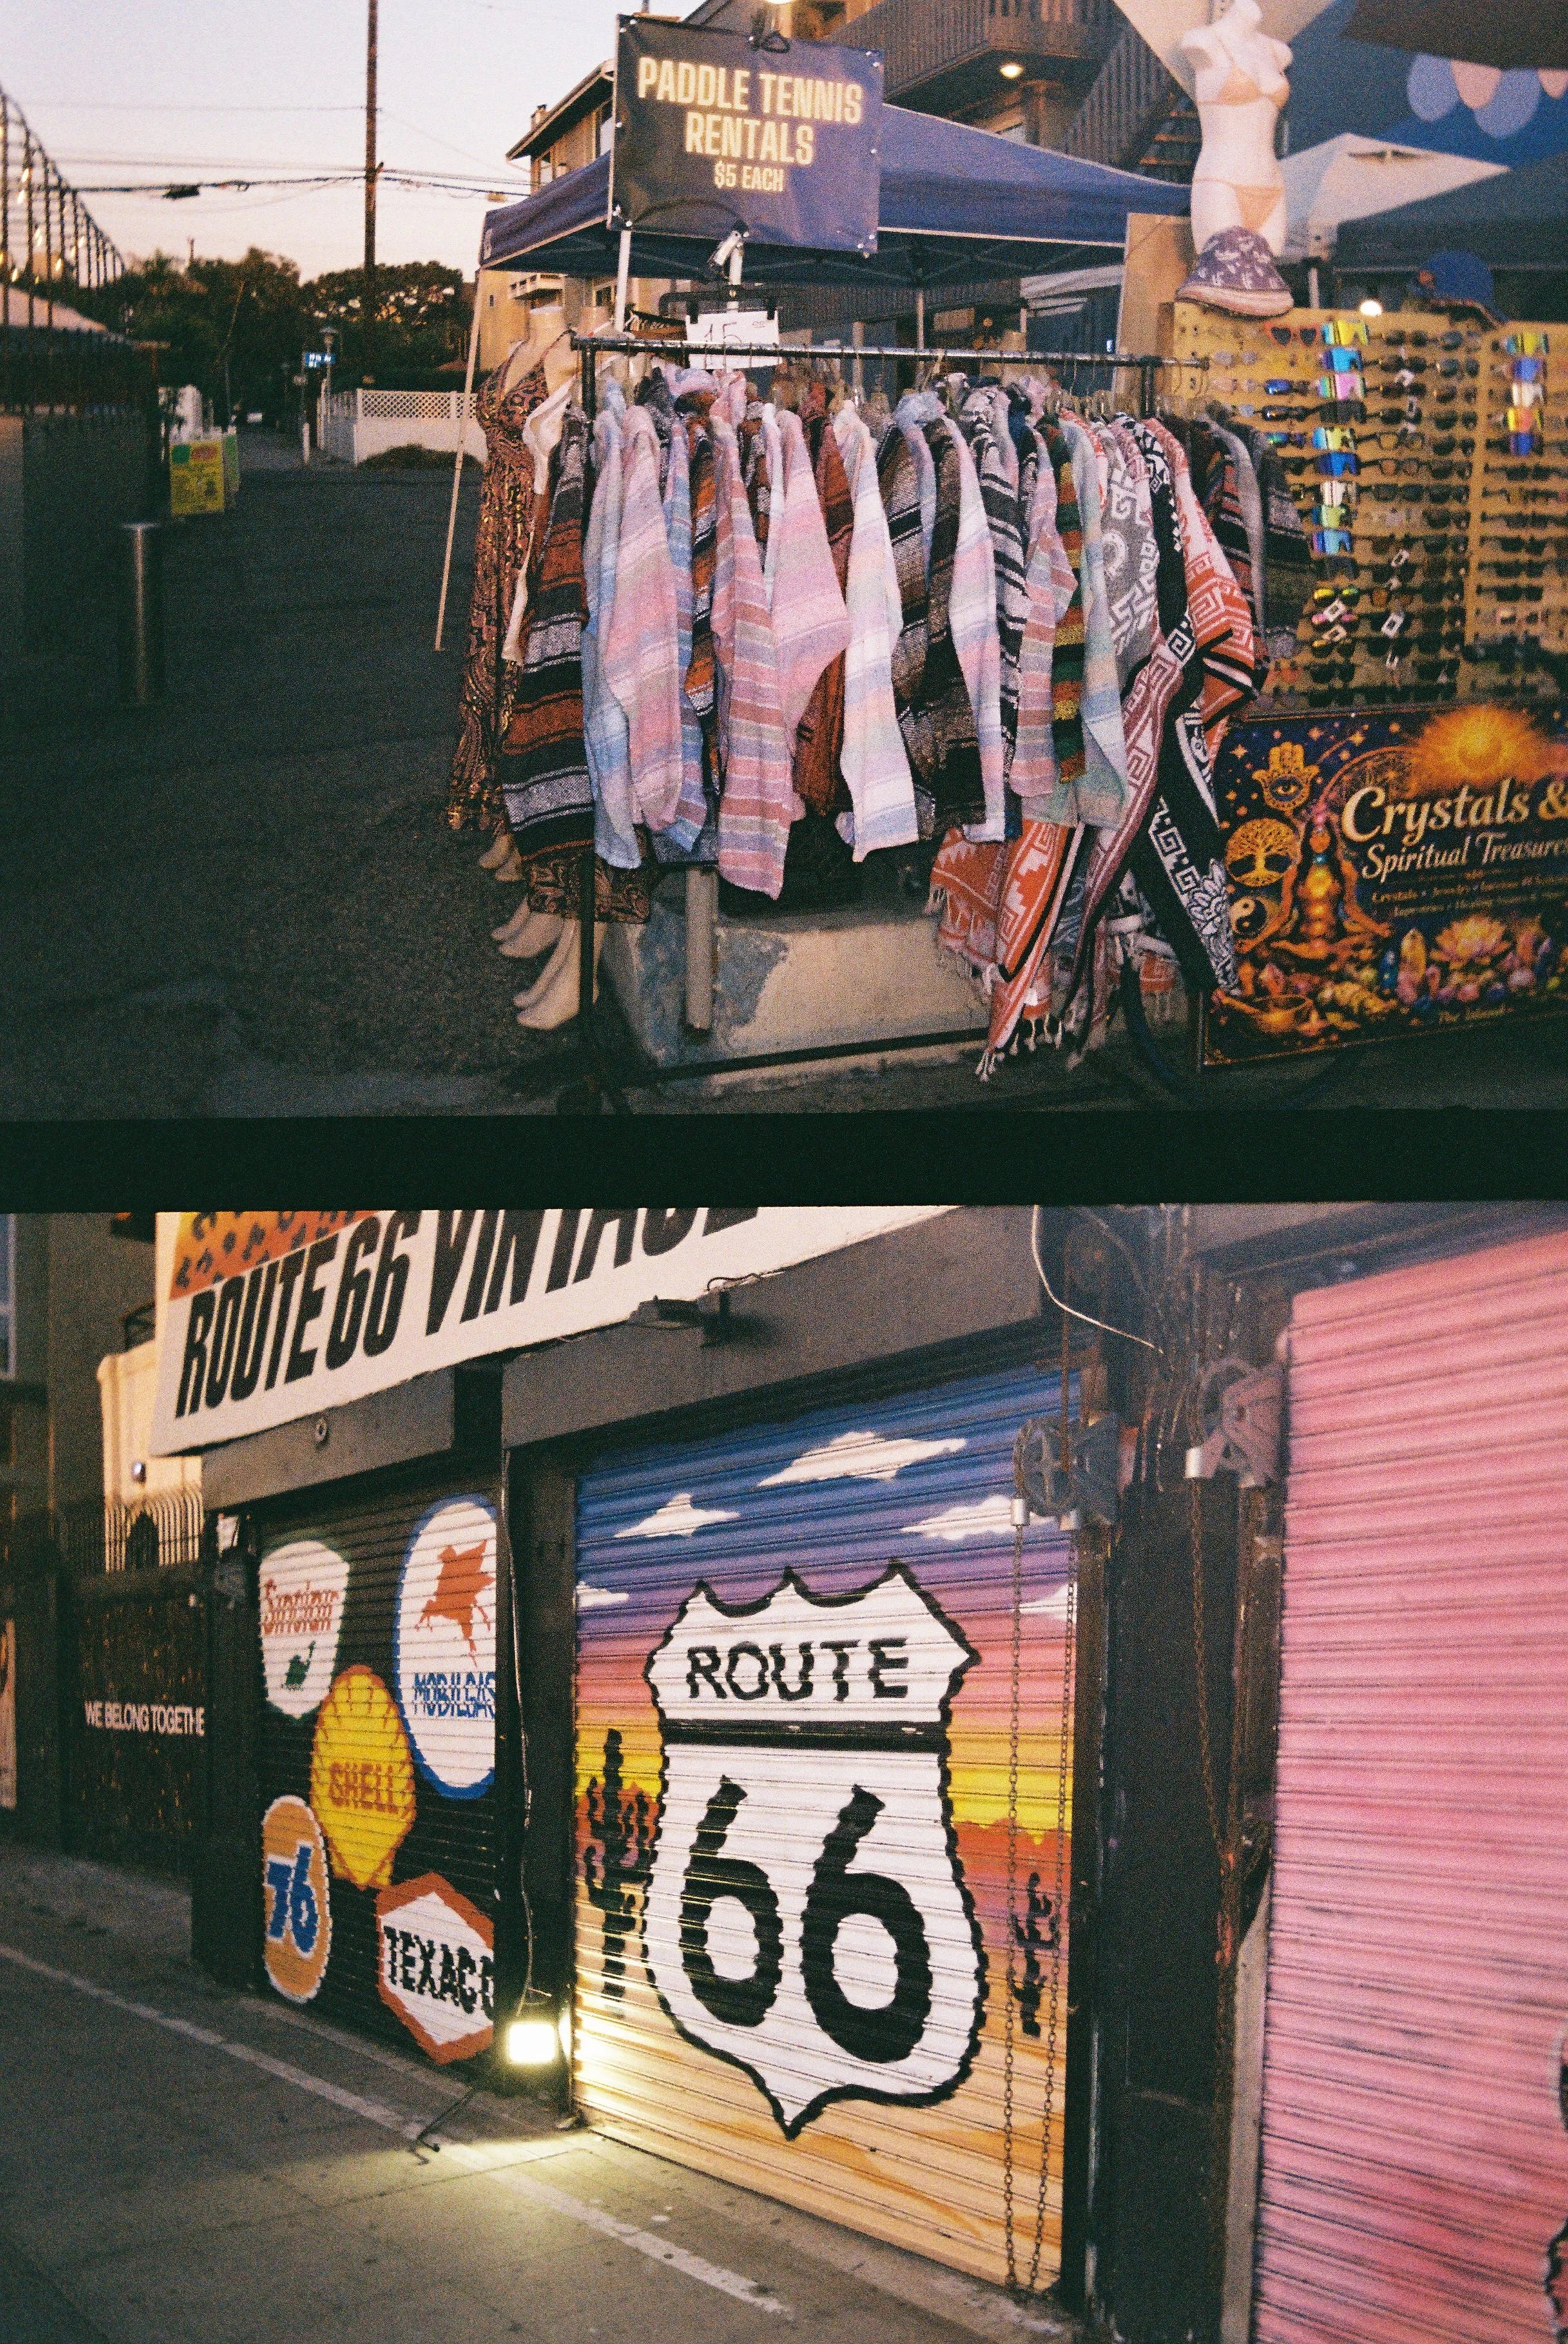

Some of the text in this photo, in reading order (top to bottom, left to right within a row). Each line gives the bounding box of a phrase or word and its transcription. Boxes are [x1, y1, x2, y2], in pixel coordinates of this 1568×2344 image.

[637, 56, 864, 124] PADDLE TENNIS
[685, 111, 814, 166] RENTALS
[713, 160, 784, 192] $5 EACH
[1342, 777, 1568, 846] Crystals &
[1362, 834, 1469, 884] Spiritual
[175, 1234, 343, 1418] ROUTE
[325, 1208, 422, 1370] 66
[686, 1638, 909, 1701] ROUTE
[84, 1700, 103, 1728] WE
[104, 1701, 149, 1733] BELONG
[266, 1842, 318, 1957] 76
[679, 1776, 933, 2062] 66
